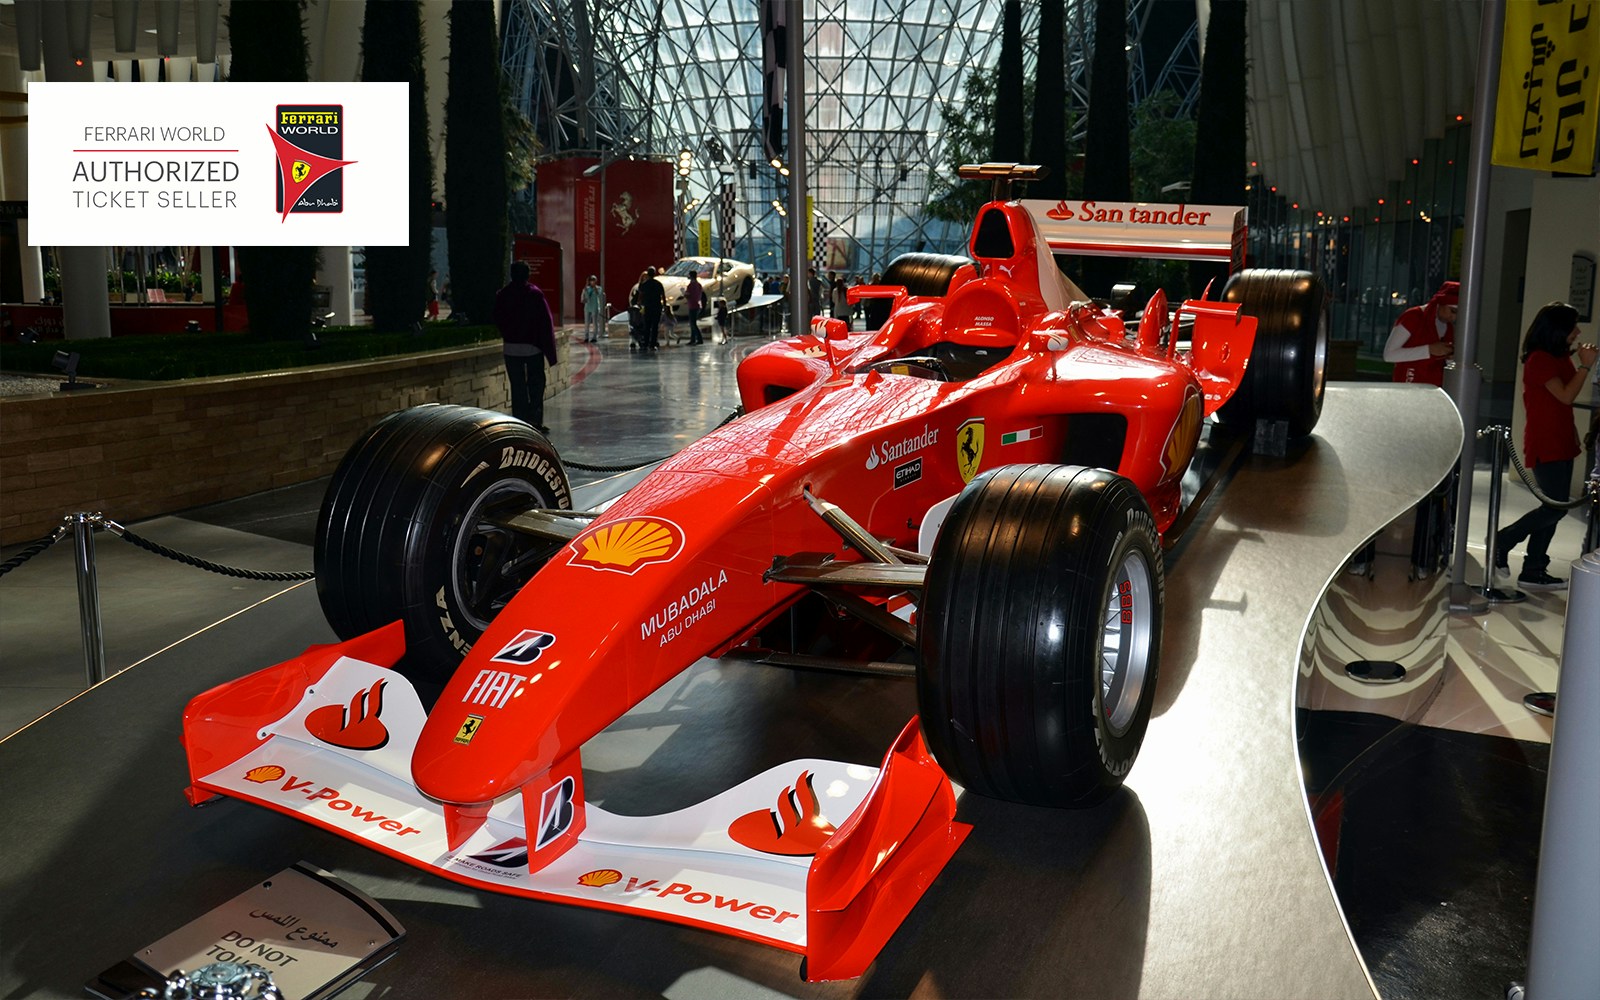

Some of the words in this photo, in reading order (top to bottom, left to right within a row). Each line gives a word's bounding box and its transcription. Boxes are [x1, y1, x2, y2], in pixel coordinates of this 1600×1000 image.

[880, 423, 940, 466] Santander
[499, 446, 570, 510] BRIDGESTO
[896, 462, 921, 480] ETIHAD
[435, 584, 473, 657] ENZA
[640, 568, 728, 641] MUBADALA
[659, 622, 683, 648] ABU
[684, 598, 716, 629] DHABI
[1119, 579, 1133, 625] BBS
[461, 669, 528, 710] FIAT
[280, 774, 421, 838] V-Power
[248, 908, 301, 929] اللمس
[624, 876, 800, 927] V-Power
[220, 930, 255, 949] DO
[249, 943, 299, 967] NOT
[285, 926, 340, 949] ممنوع
